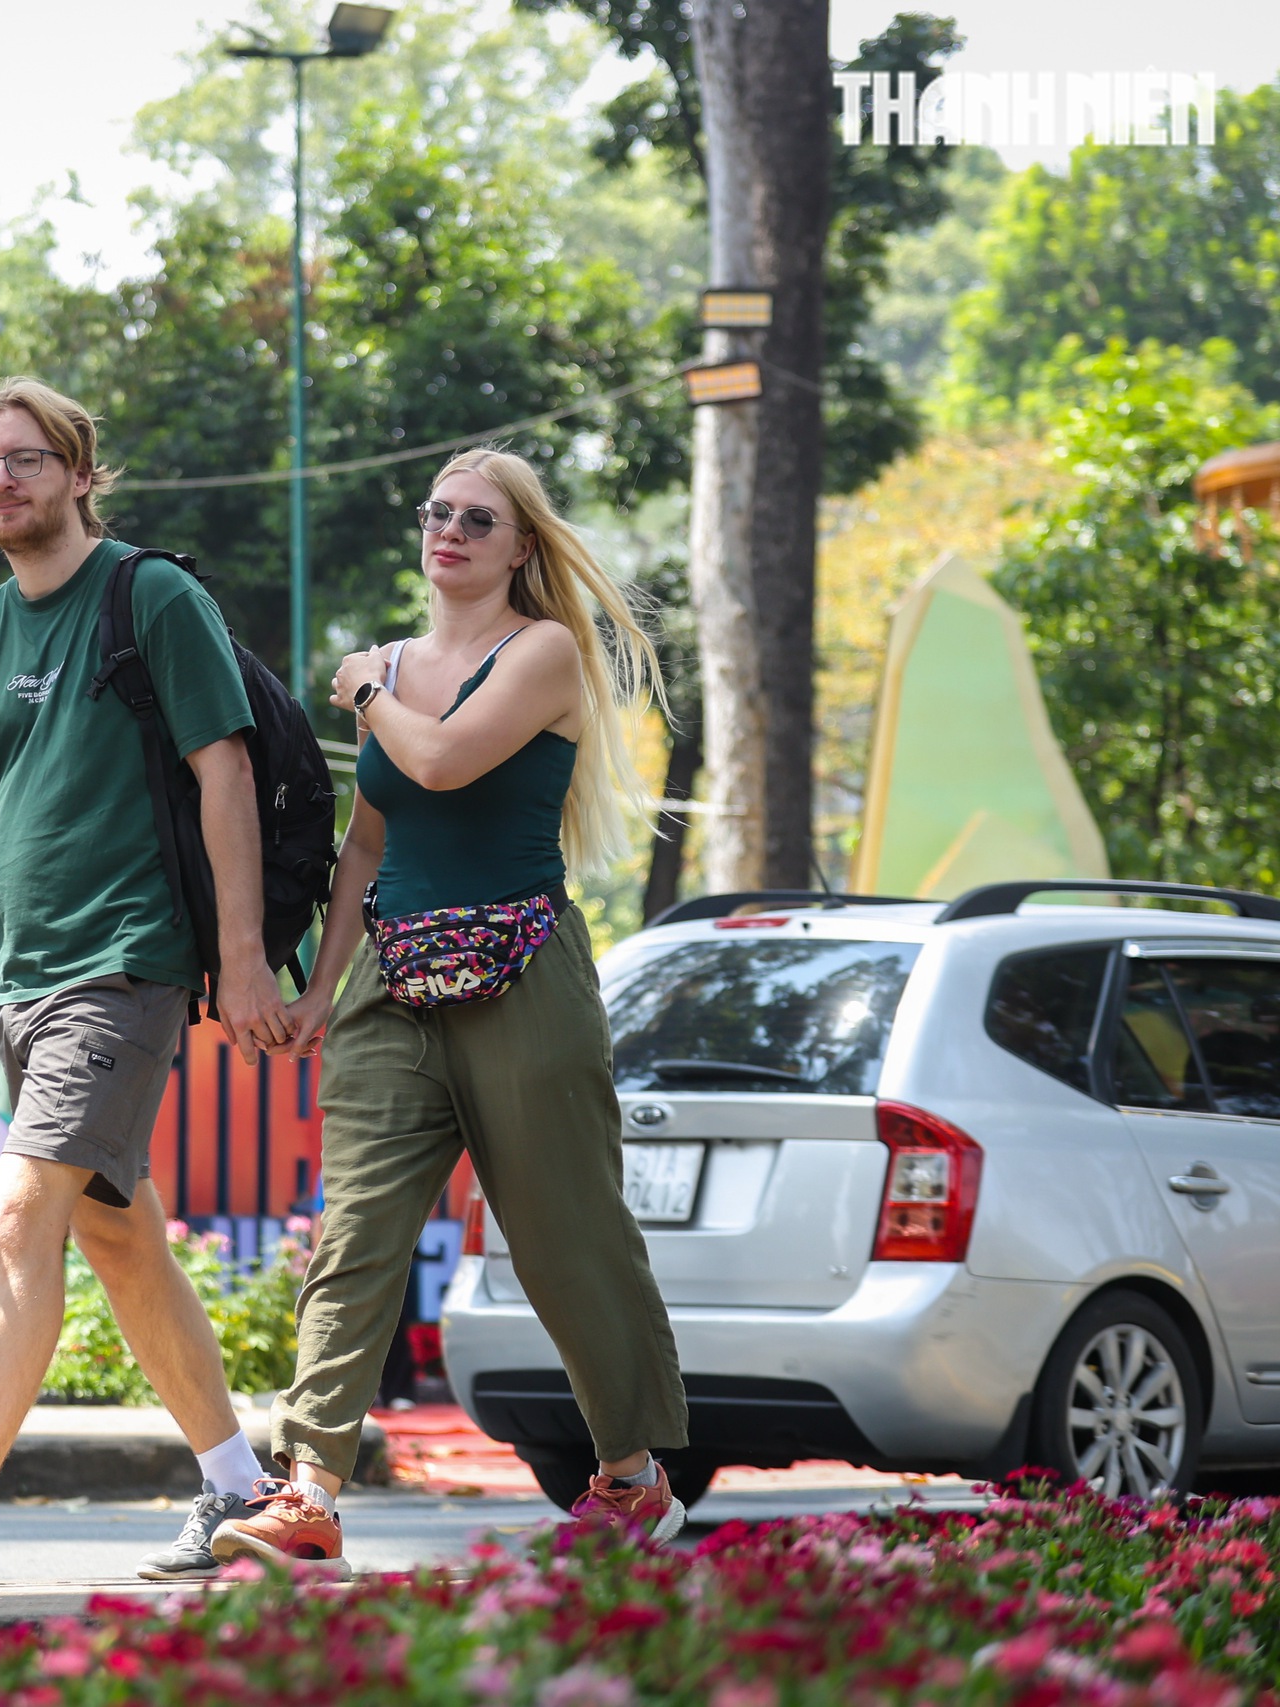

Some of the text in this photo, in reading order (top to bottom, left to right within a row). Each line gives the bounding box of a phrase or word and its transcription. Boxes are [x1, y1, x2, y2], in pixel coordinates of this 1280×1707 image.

[6, 674, 41, 691] New
[405, 968, 482, 997] FILA
[623, 1181, 691, 1214] 04.12
